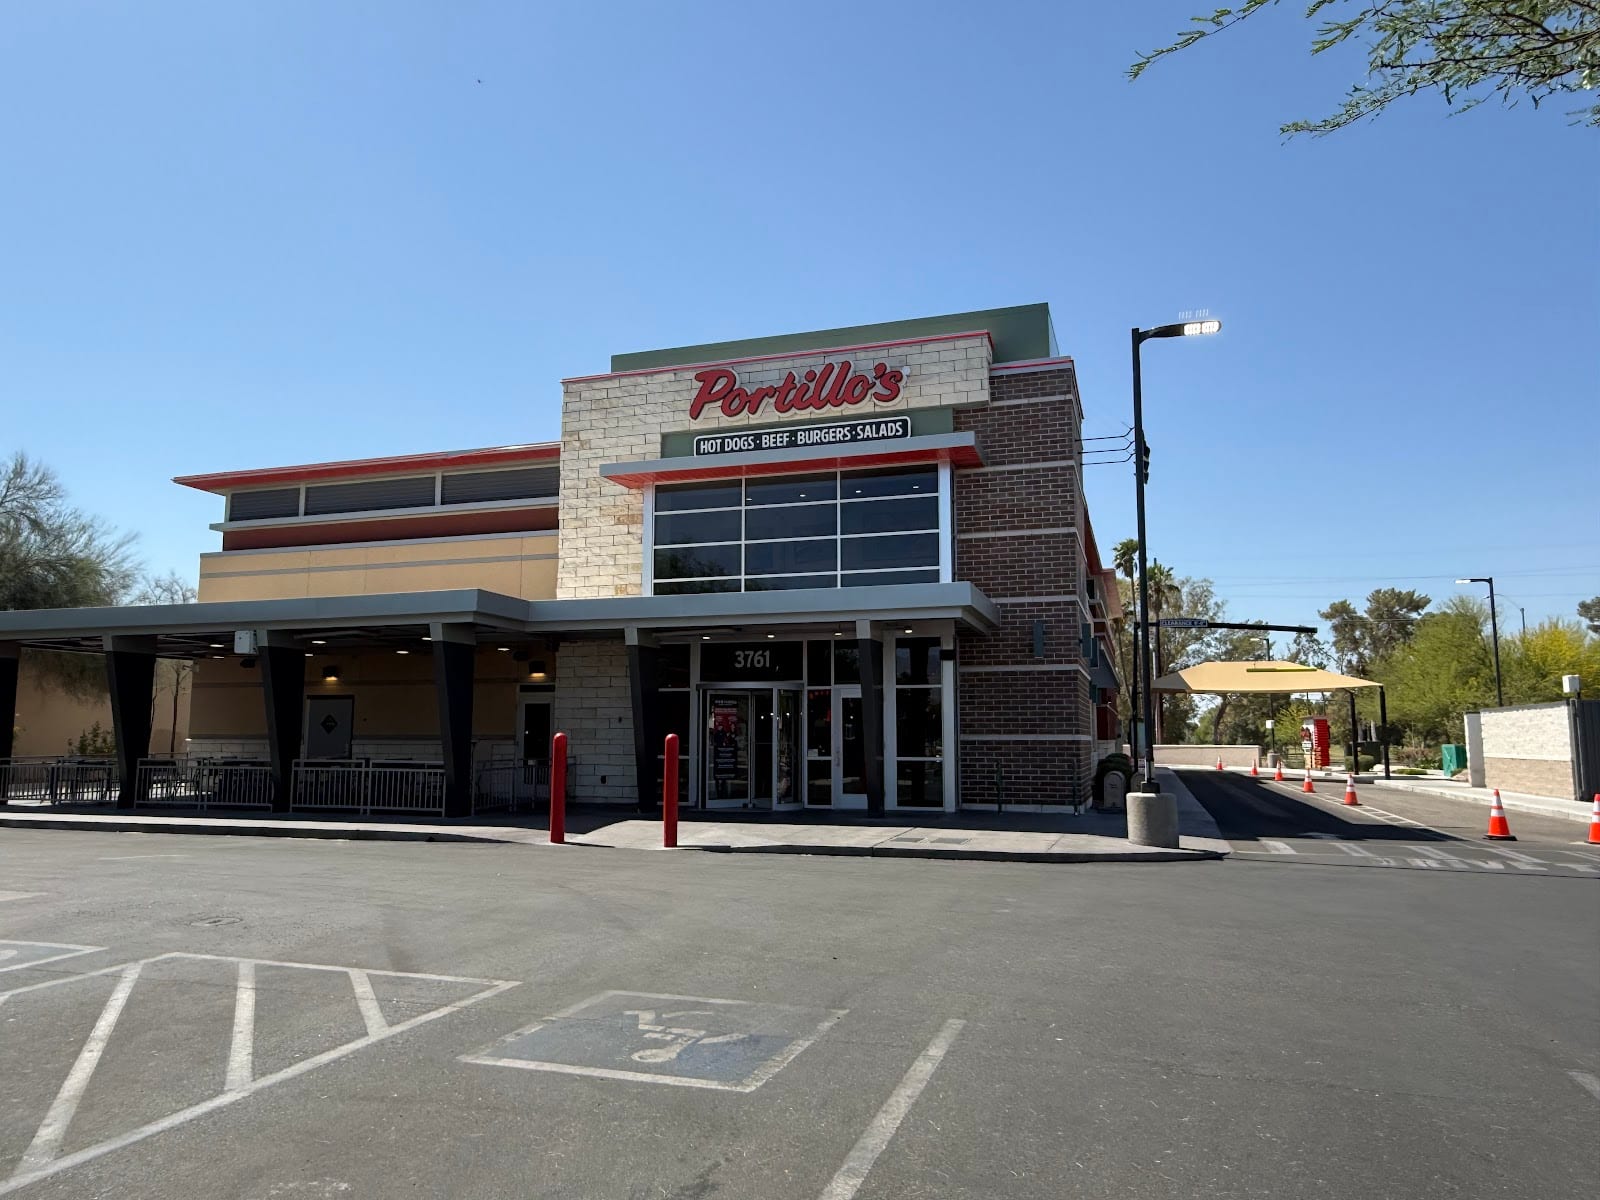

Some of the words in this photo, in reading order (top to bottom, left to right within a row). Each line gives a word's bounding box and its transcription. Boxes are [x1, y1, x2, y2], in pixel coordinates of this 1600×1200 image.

[689, 360, 903, 420] Portillo's
[700, 438, 721, 454] HOT
[724, 436, 755, 451] DOGS
[761, 432, 789, 448] BEEF
[797, 426, 851, 445] BURGERS
[857, 421, 903, 440] SALADS
[735, 650, 770, 668] 3761
